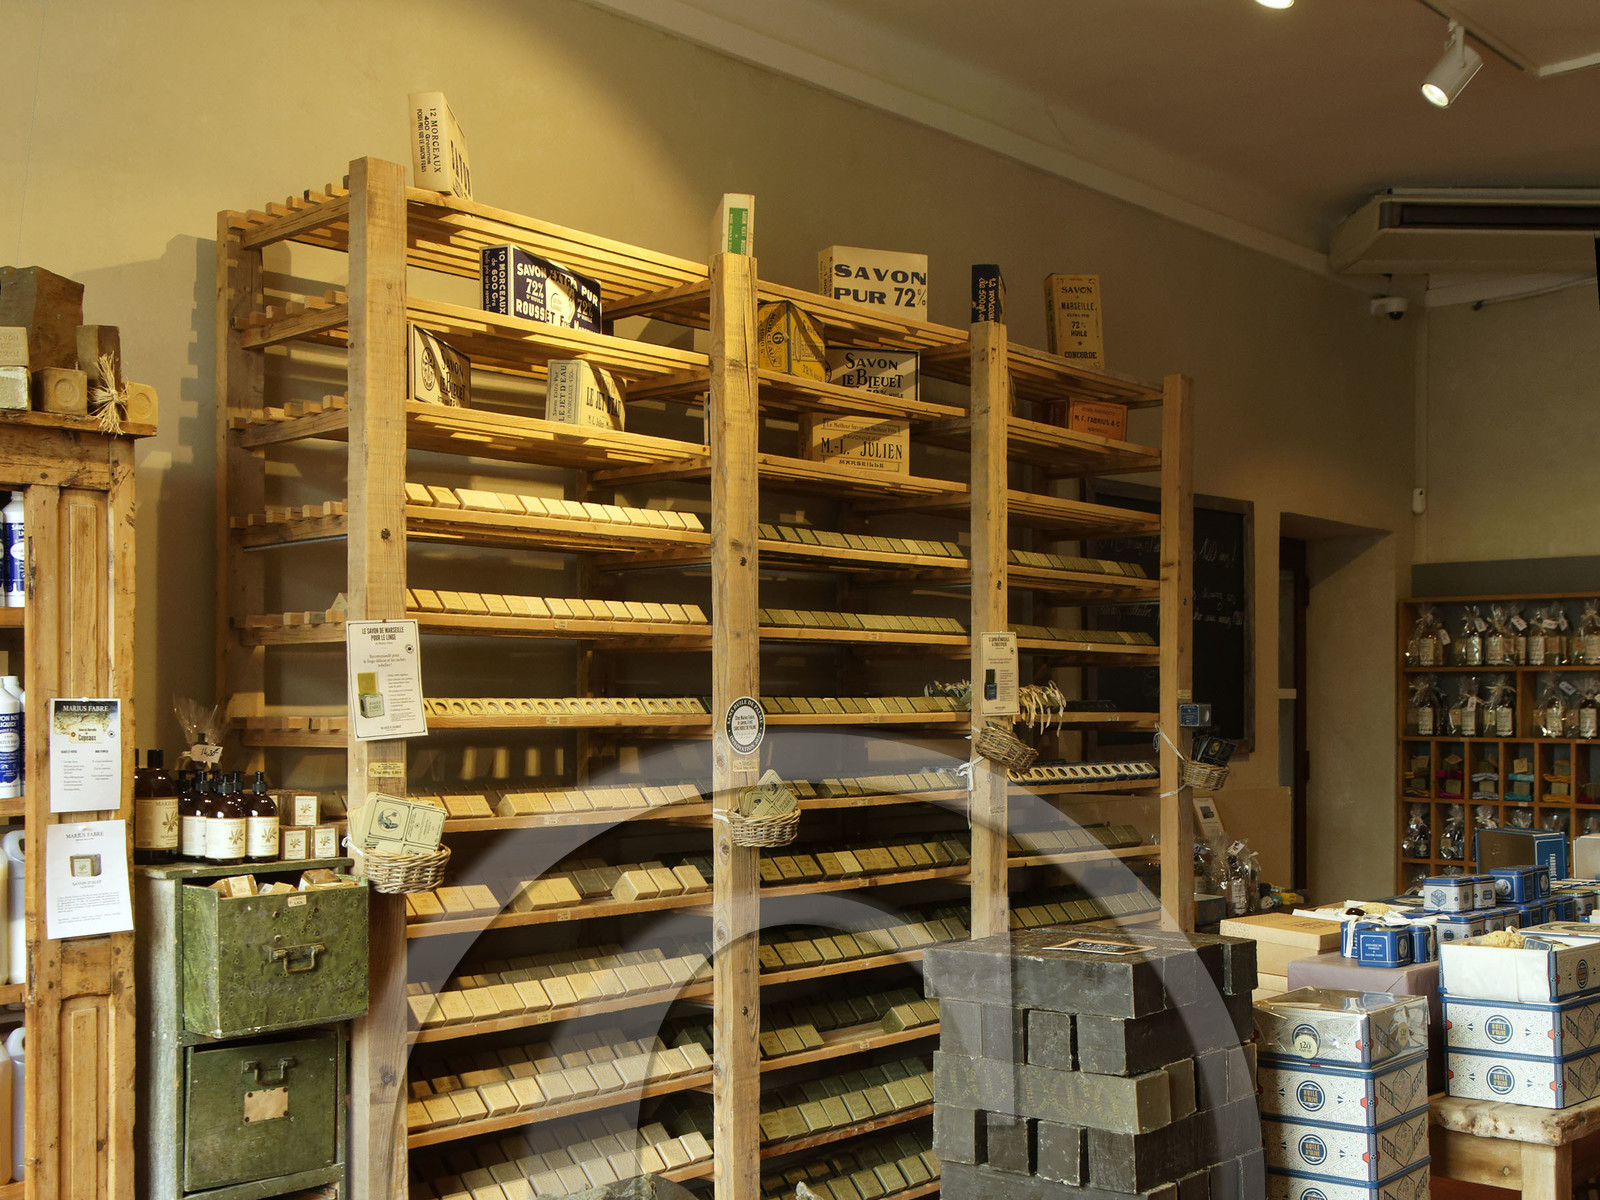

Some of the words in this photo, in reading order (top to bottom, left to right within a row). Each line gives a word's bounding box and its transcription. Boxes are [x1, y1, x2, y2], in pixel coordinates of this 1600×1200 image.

[430, 108, 436, 117] 12
[430, 120, 441, 173] MORCEAUX
[492, 258, 498, 266] de
[498, 250, 506, 261] 10
[516, 262, 547, 278] SAVON
[550, 270, 578, 292] EXTRA
[581, 285, 598, 307] PUR
[834, 264, 926, 286] SAVON
[526, 278, 544, 299] 72%
[577, 300, 593, 318] 72%
[834, 287, 886, 304] PUR
[894, 287, 926, 308] 72%
[978, 290, 986, 304] 500
[1061, 286, 1093, 294] SAVON
[516, 298, 556, 324] ROUSSET
[1061, 302, 1095, 311] MARSEILLE
[767, 312, 777, 364] MORCEAUX
[845, 352, 898, 370] SAVON
[1064, 351, 1098, 359] CONCORDE
[842, 374, 860, 388] LE
[856, 368, 904, 390] BLEUET
[586, 387, 594, 407] LE
[596, 391, 606, 411] JET
[607, 395, 621, 418] D'EAU
[559, 410, 566, 422] LE
[821, 437, 850, 455] M.-L.
[860, 440, 902, 460] JULIEN
[839, 460, 884, 468] MARSEILLE
[733, 699, 748, 709] HUILE
[754, 704, 764, 724] PALME
